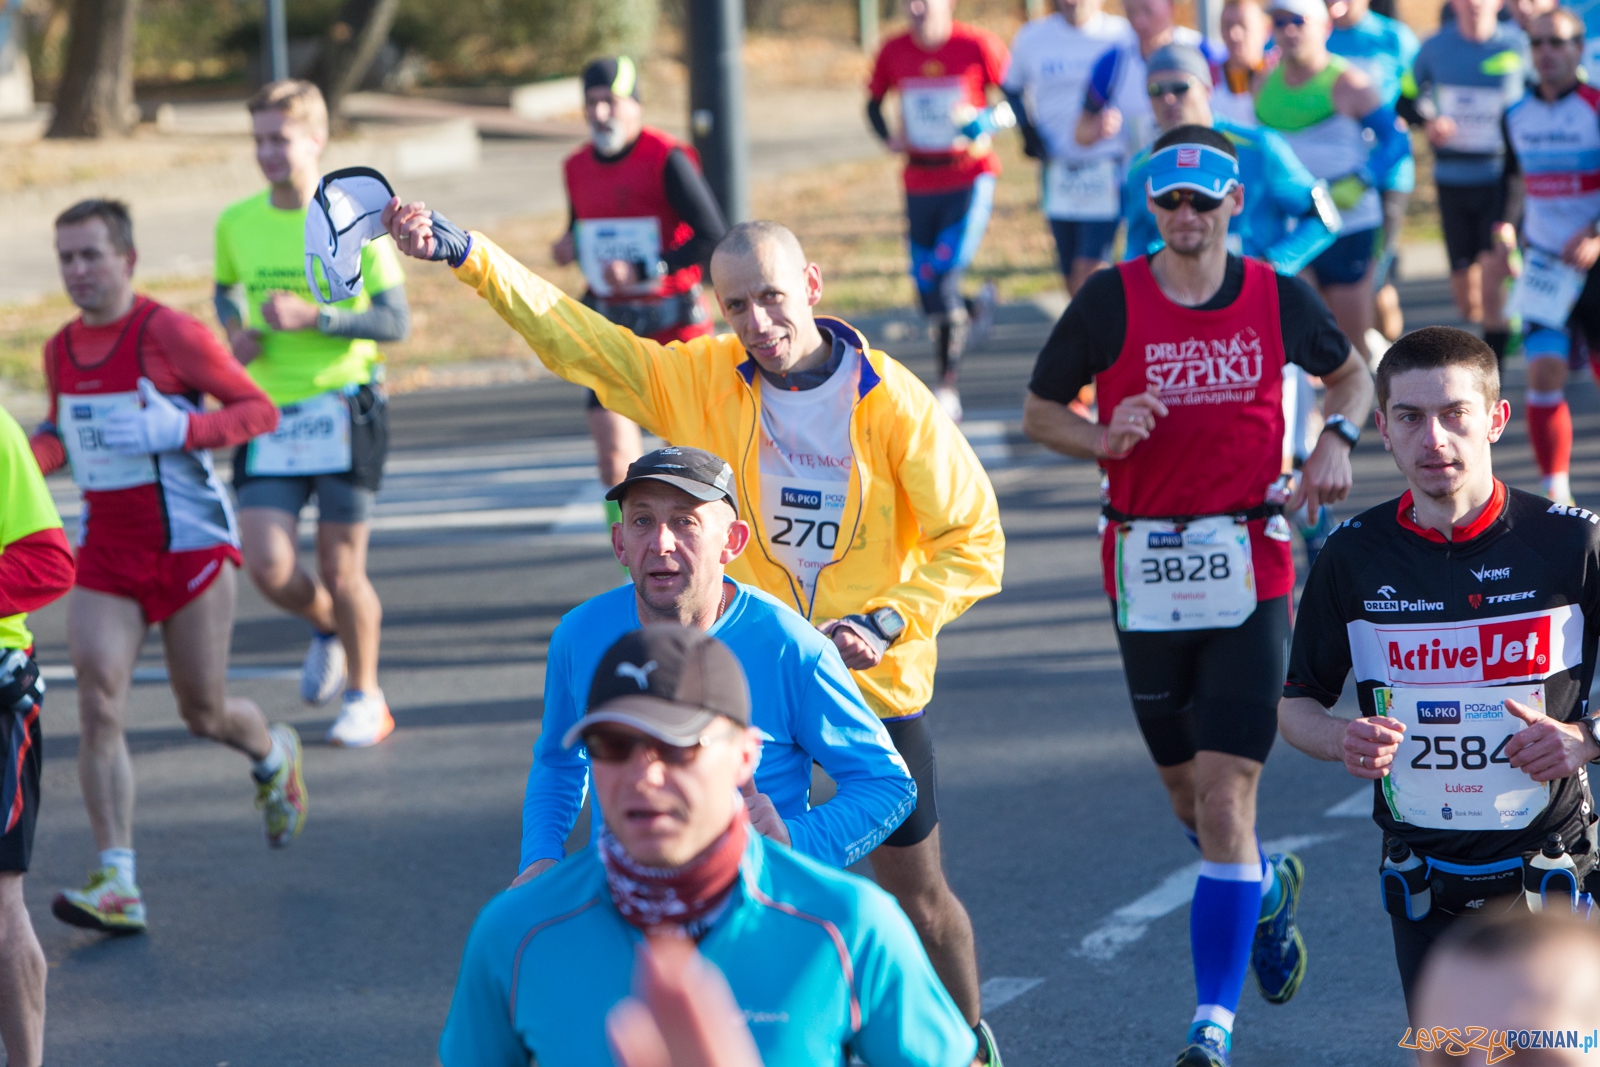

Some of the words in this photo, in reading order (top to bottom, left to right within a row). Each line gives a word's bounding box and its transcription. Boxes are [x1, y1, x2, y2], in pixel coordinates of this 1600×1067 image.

[1145, 337, 1243, 363] DRUŻYNA
[1146, 354, 1263, 390] SZPIKU
[771, 515, 840, 550] 270
[1141, 553, 1230, 584] 3828
[1486, 590, 1537, 604] TREK
[1366, 602, 1397, 611] ORLEN
[1400, 600, 1444, 612] Paliwa
[1436, 707, 1457, 718] PKO
[1465, 711, 1504, 719] maraton
[1410, 734, 1515, 770] 2584
[1445, 782, 1484, 793] Łukasz
[1465, 898, 1485, 909] 4F
